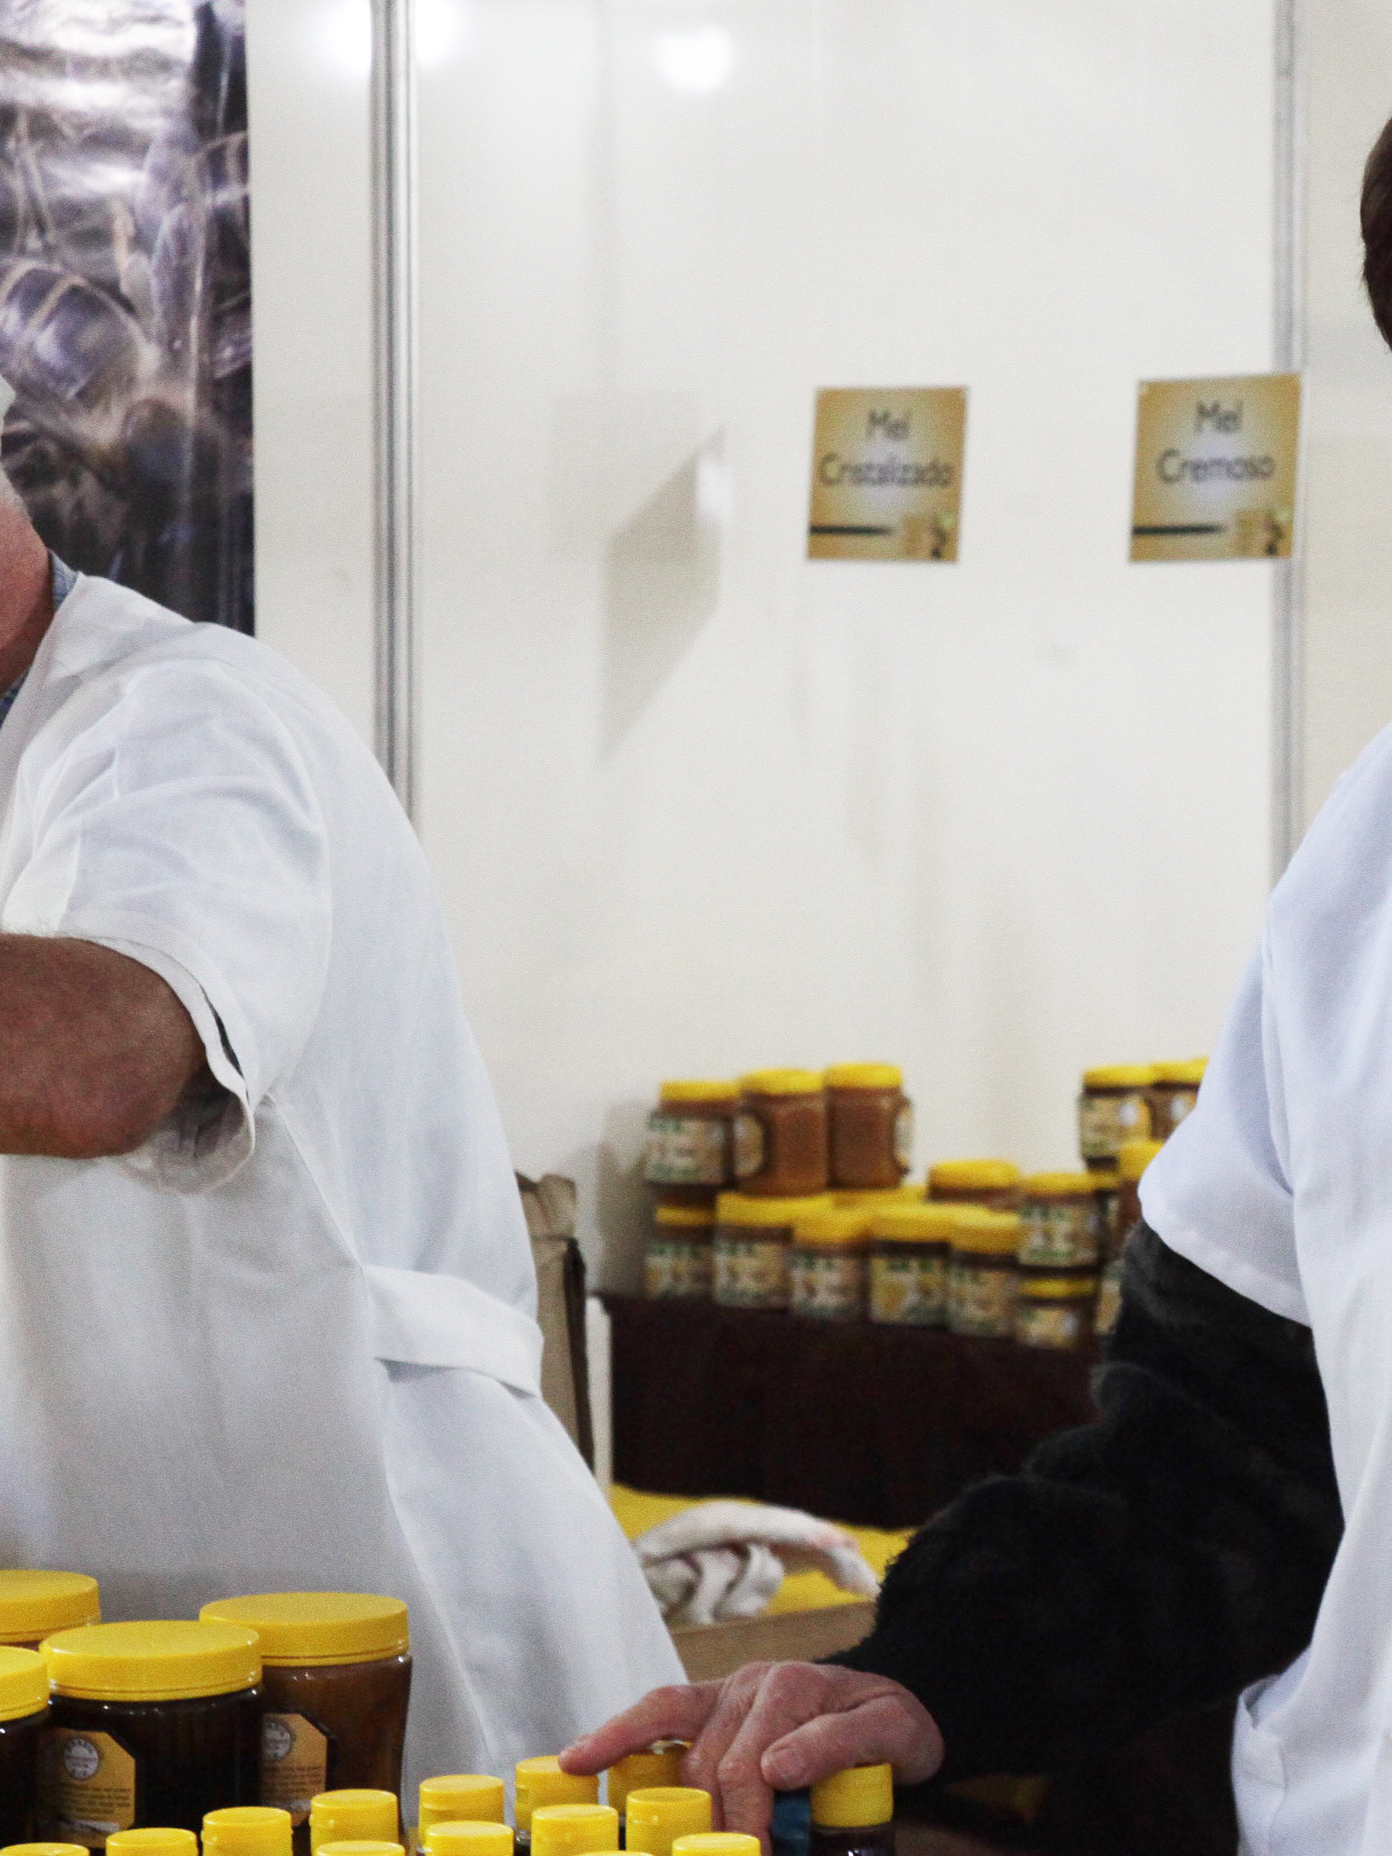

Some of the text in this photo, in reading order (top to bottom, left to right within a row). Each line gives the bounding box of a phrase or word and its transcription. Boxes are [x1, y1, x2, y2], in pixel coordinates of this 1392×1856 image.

[867, 410, 911, 441] Mel
[1195, 400, 1243, 433] Mel
[1155, 448, 1276, 484] Cremoso
